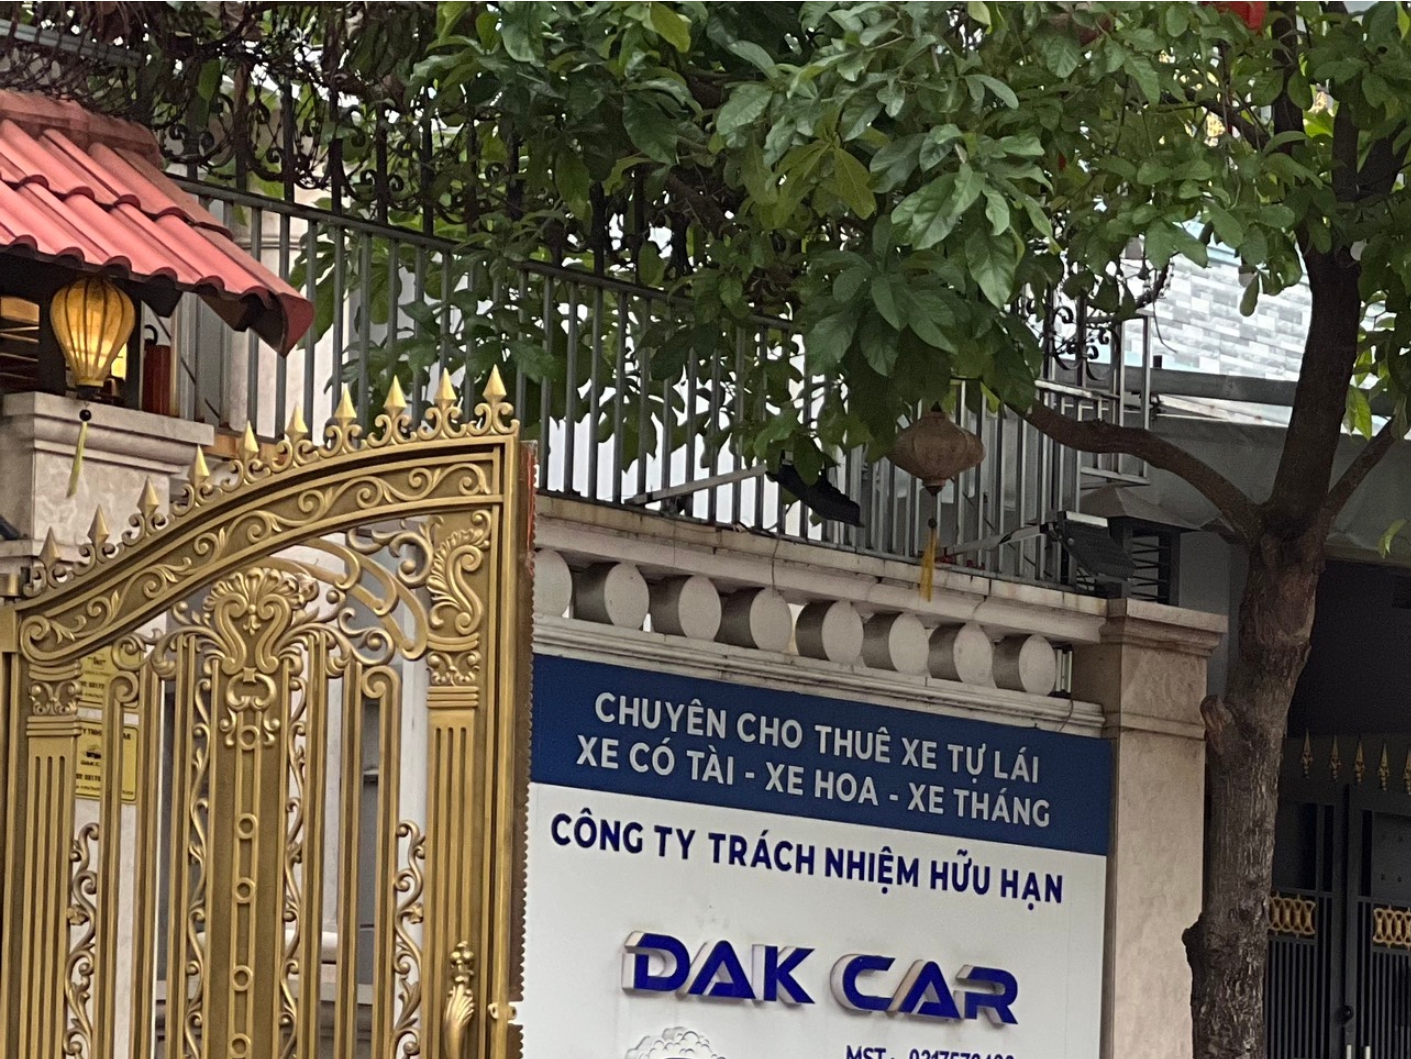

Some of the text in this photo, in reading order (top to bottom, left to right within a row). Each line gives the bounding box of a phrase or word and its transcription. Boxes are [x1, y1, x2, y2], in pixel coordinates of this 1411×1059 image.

[576, 735, 618, 769] XE
[629, 742, 675, 776] CÓ
[686, 746, 734, 786] TÀI
[765, 763, 803, 794] XE
[813, 770, 878, 806] HOA
[907, 783, 943, 815] XE
[952, 790, 1050, 827] THÁNG
[594, 690, 1039, 784] CHUYÊN CHO THUÊ XE TỰ LÁI
[551, 807, 1063, 911] CÔNG TY TRÁCH NHIỆM HỮU HẠN
[621, 931, 1019, 1026] DAK CAR
